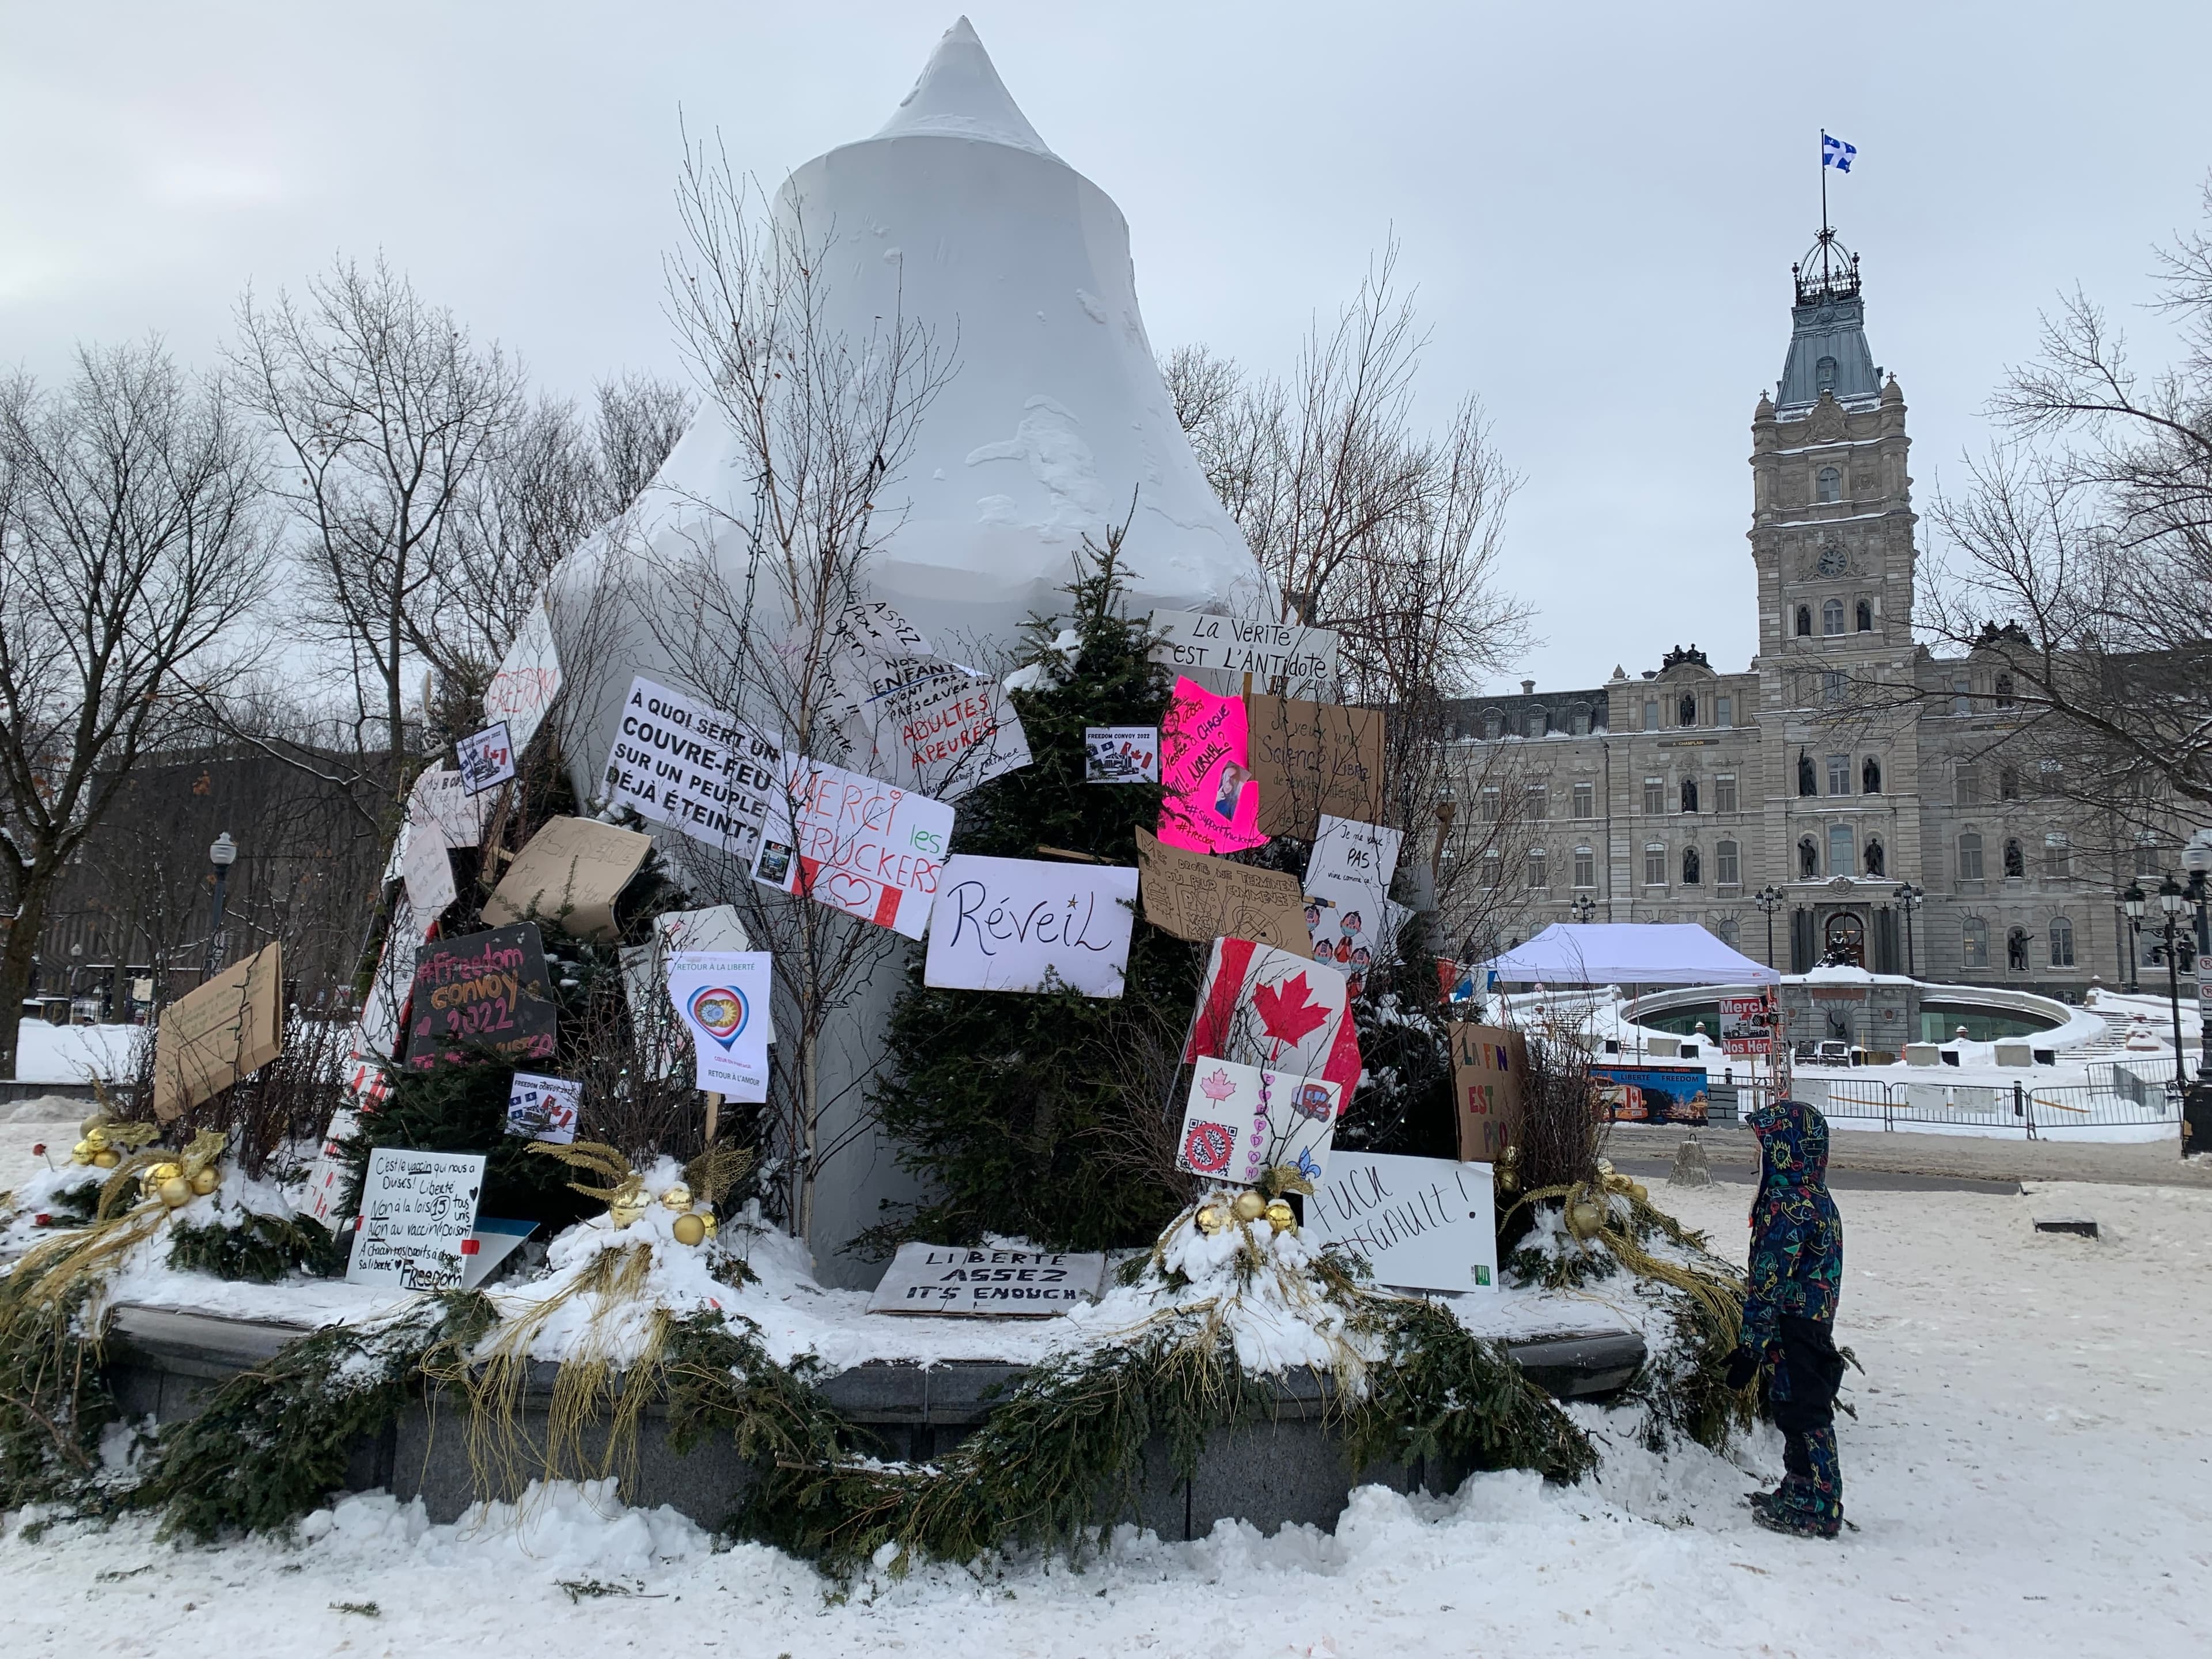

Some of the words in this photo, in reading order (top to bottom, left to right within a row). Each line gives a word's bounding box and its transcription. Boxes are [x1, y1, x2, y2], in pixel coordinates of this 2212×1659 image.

[631, 688, 643, 708] À
[647, 698, 693, 729] QUOI
[696, 718, 745, 748] SERT
[751, 738, 778, 763] UN
[903, 693, 988, 747] ADULTES
[622, 716, 773, 791] COUVRE-FEU
[441, 776, 463, 790] BOD
[614, 743, 652, 771] SUR
[656, 759, 683, 784] UN
[688, 777, 763, 818] PEUPLE
[605, 766, 657, 804] DÉJÀ
[662, 789, 759, 844] ÉTEINT?
[796, 820, 942, 893] TRUCKERS
[1346, 847, 1370, 869] PAS
[1190, 874, 1218, 892] PEUR
[1226, 884, 1289, 907] COMMENCE
[676, 963, 708, 971] RETOUR
[709, 961, 715, 971] À
[727, 962, 756, 971] LIBERTÉ
[446, 997, 514, 1036] 2022
[1719, 999, 1763, 1014] Merci
[1462, 1037, 1480, 1066] LA
[1483, 1043, 1509, 1071] FIN
[1722, 1040, 1744, 1054] Nos
[514, 1080, 538, 1089] FREEDOM
[707, 1069, 732, 1080] RETOUR
[731, 1072, 737, 1081] À
[737, 1074, 760, 1086] L'AMOUR
[1620, 1073, 1651, 1081] LIBERTÉ
[1661, 1075, 1699, 1083] FREEDOM
[1468, 1085, 1494, 1115] EST
[433, 1162, 446, 1179] qui
[448, 1164, 467, 1173] nous
[371, 1199, 393, 1217] Non
[403, 1198, 411, 1213] la
[390, 1224, 404, 1237] au
[906, 1285, 961, 1300] IT'S
[973, 1287, 1077, 1301] ENOUGH
